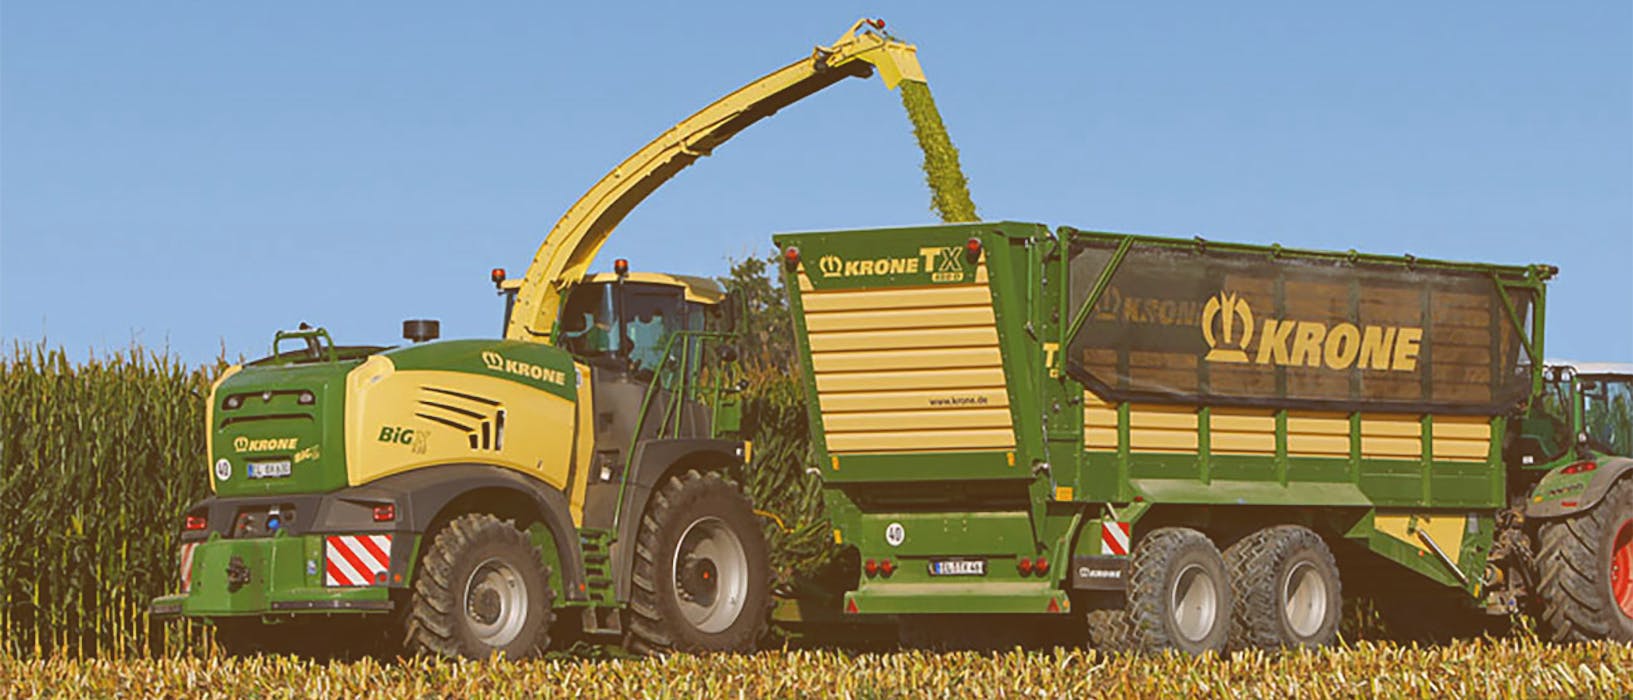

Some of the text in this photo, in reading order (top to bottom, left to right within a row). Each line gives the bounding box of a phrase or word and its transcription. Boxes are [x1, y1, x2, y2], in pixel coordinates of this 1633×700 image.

[844, 257, 919, 277] KRONE
[919, 246, 963, 273] TX
[1255, 319, 1413, 371] KRONE
[505, 359, 566, 386] KRONE
[248, 438, 298, 452] KRONE
[888, 526, 902, 542] 40
